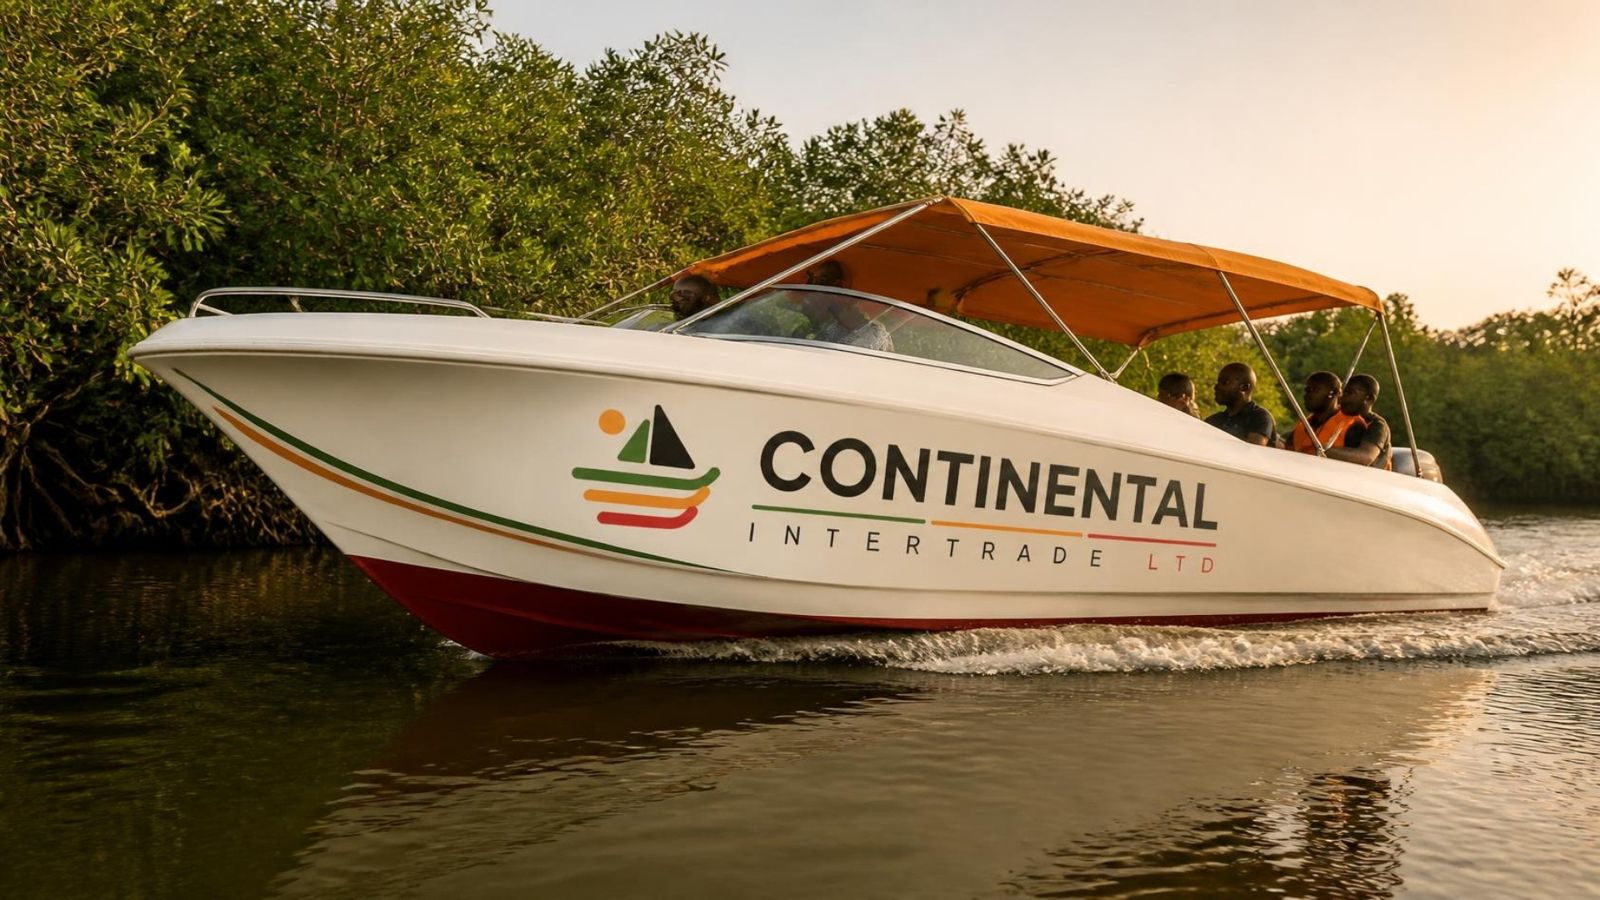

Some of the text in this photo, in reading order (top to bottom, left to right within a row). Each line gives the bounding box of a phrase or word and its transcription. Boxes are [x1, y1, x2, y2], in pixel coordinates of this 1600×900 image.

[760, 430, 1218, 530] CONTINENTAL
[749, 522, 1214, 573] INTERTRADE LTD
